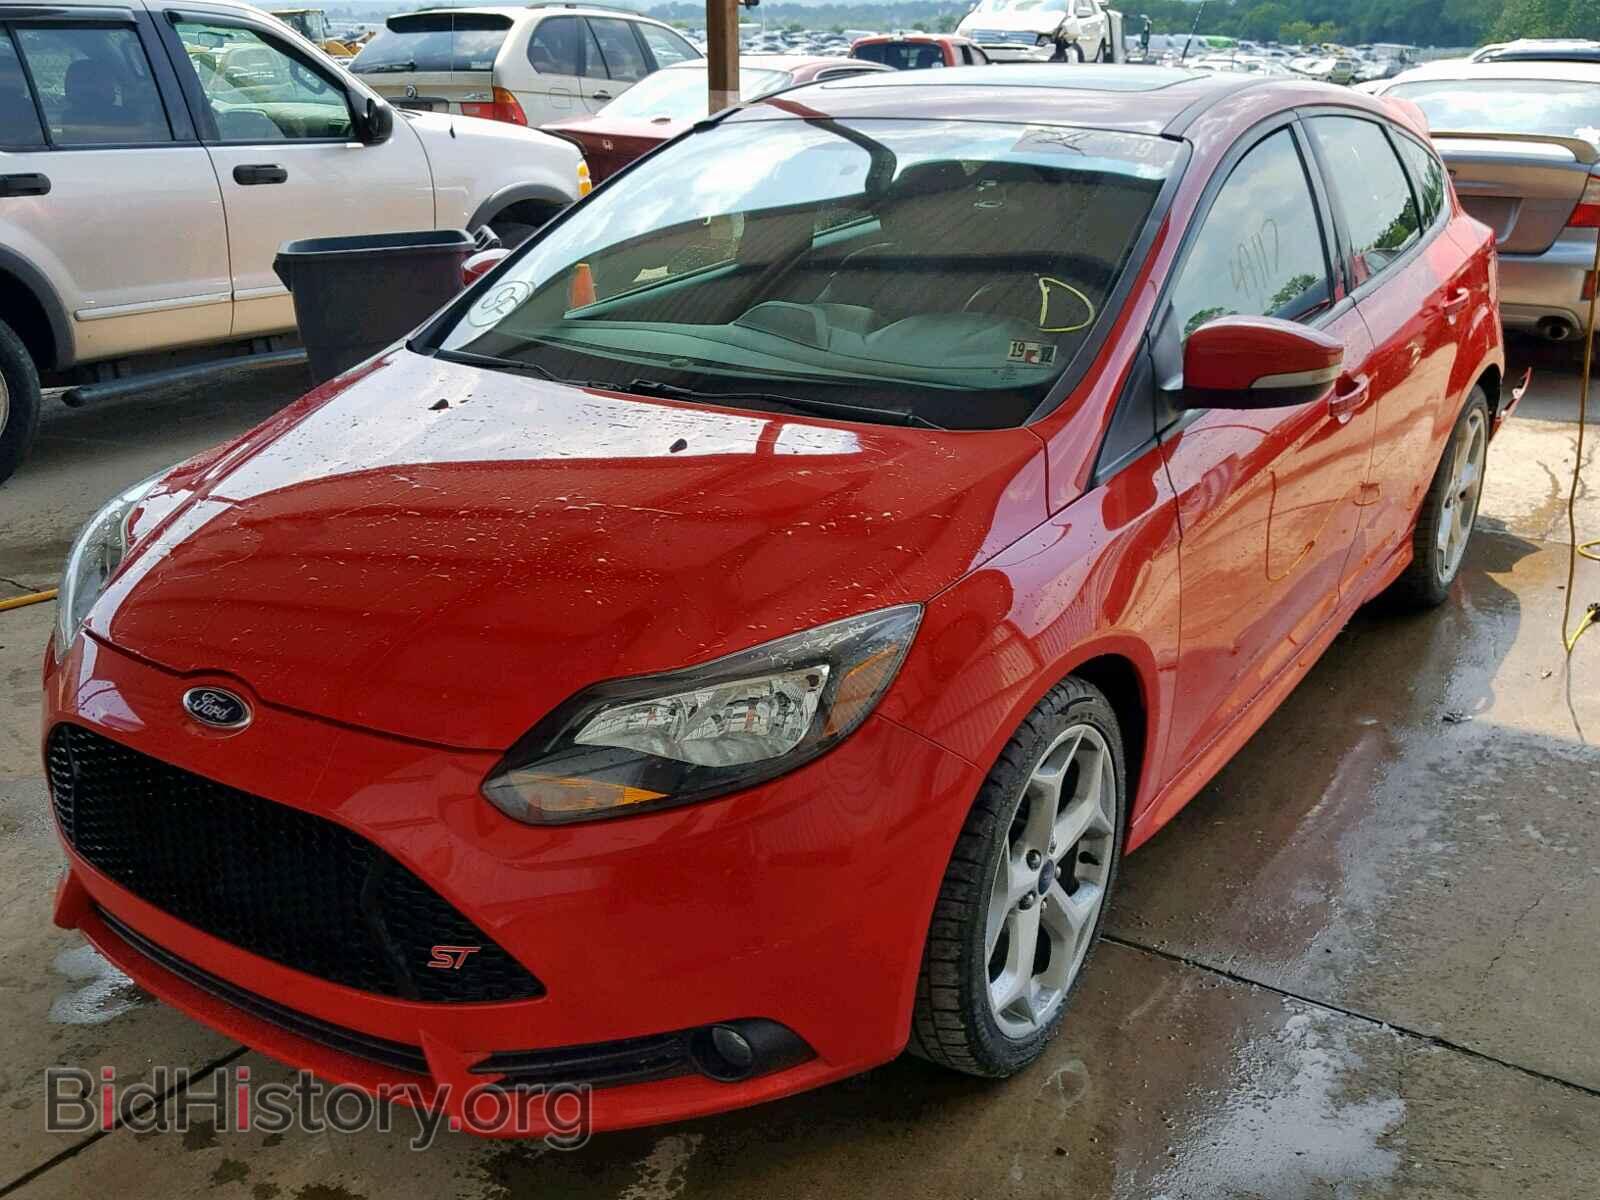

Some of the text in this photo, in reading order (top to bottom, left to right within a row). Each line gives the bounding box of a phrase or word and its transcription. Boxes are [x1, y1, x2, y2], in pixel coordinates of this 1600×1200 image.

[1038, 276, 1095, 333] D
[1010, 341, 1026, 358] 19
[193, 692, 234, 720] Ford
[427, 945, 482, 969] ST
